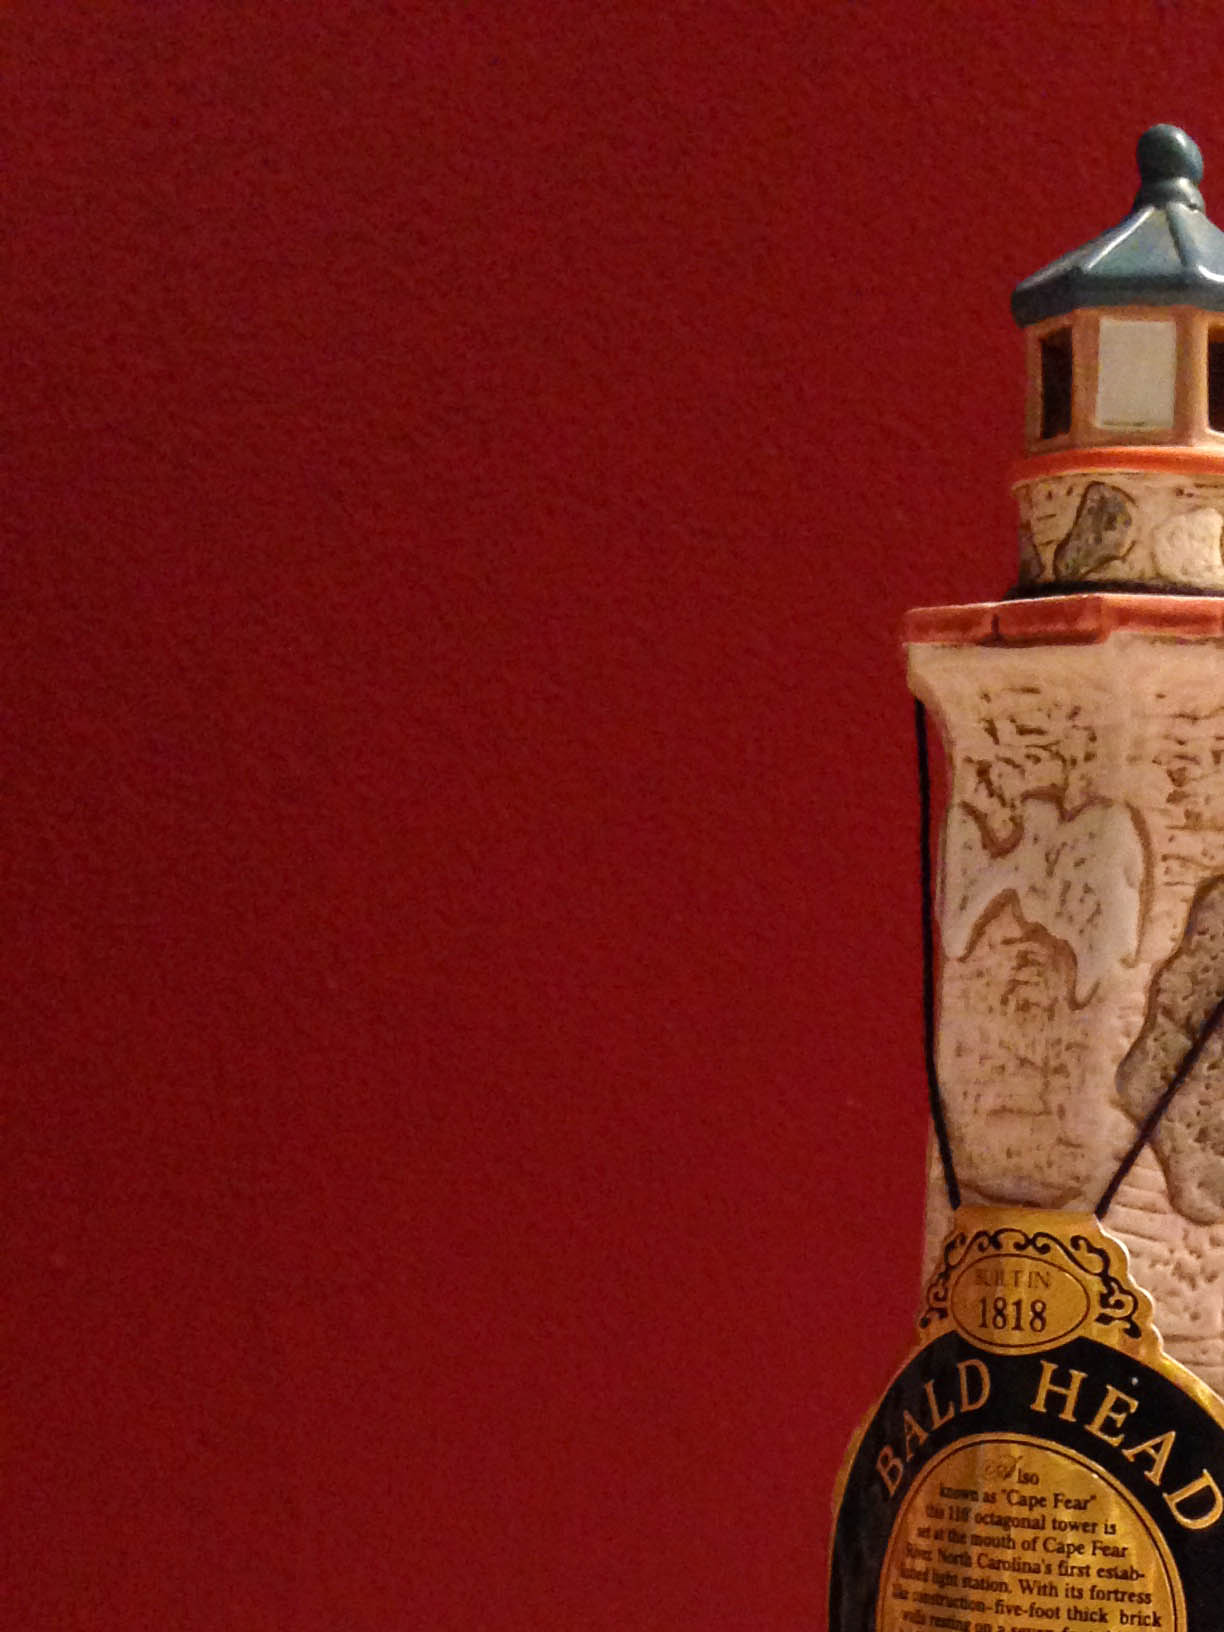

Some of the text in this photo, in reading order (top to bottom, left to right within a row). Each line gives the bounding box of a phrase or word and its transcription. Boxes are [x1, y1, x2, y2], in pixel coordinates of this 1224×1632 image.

[977, 1295, 1048, 1333] 1818
[875, 1358, 1224, 1531] BALD HEAD
[982, 1491, 997, 1504] as
[974, 1511, 1046, 1532] octagonal
[1052, 1517, 1098, 1534] tower
[1104, 1519, 1117, 1535] is
[970, 1533, 1016, 1550] mouth
[1021, 1536, 1040, 1552] of
[1042, 1536, 1086, 1558] Cape
[1091, 1540, 1129, 1558] Fear
[976, 1551, 1052, 1576] Carolina's
[1057, 1560, 1091, 1578] first
[1096, 1564, 1145, 1581] estab-
[1018, 1578, 1059, 1598] With
[1064, 1583, 1084, 1600] its
[1089, 1585, 1152, 1605] fortress
[1066, 1605, 1108, 1624] thick
[1119, 1609, 1162, 1628] brick
